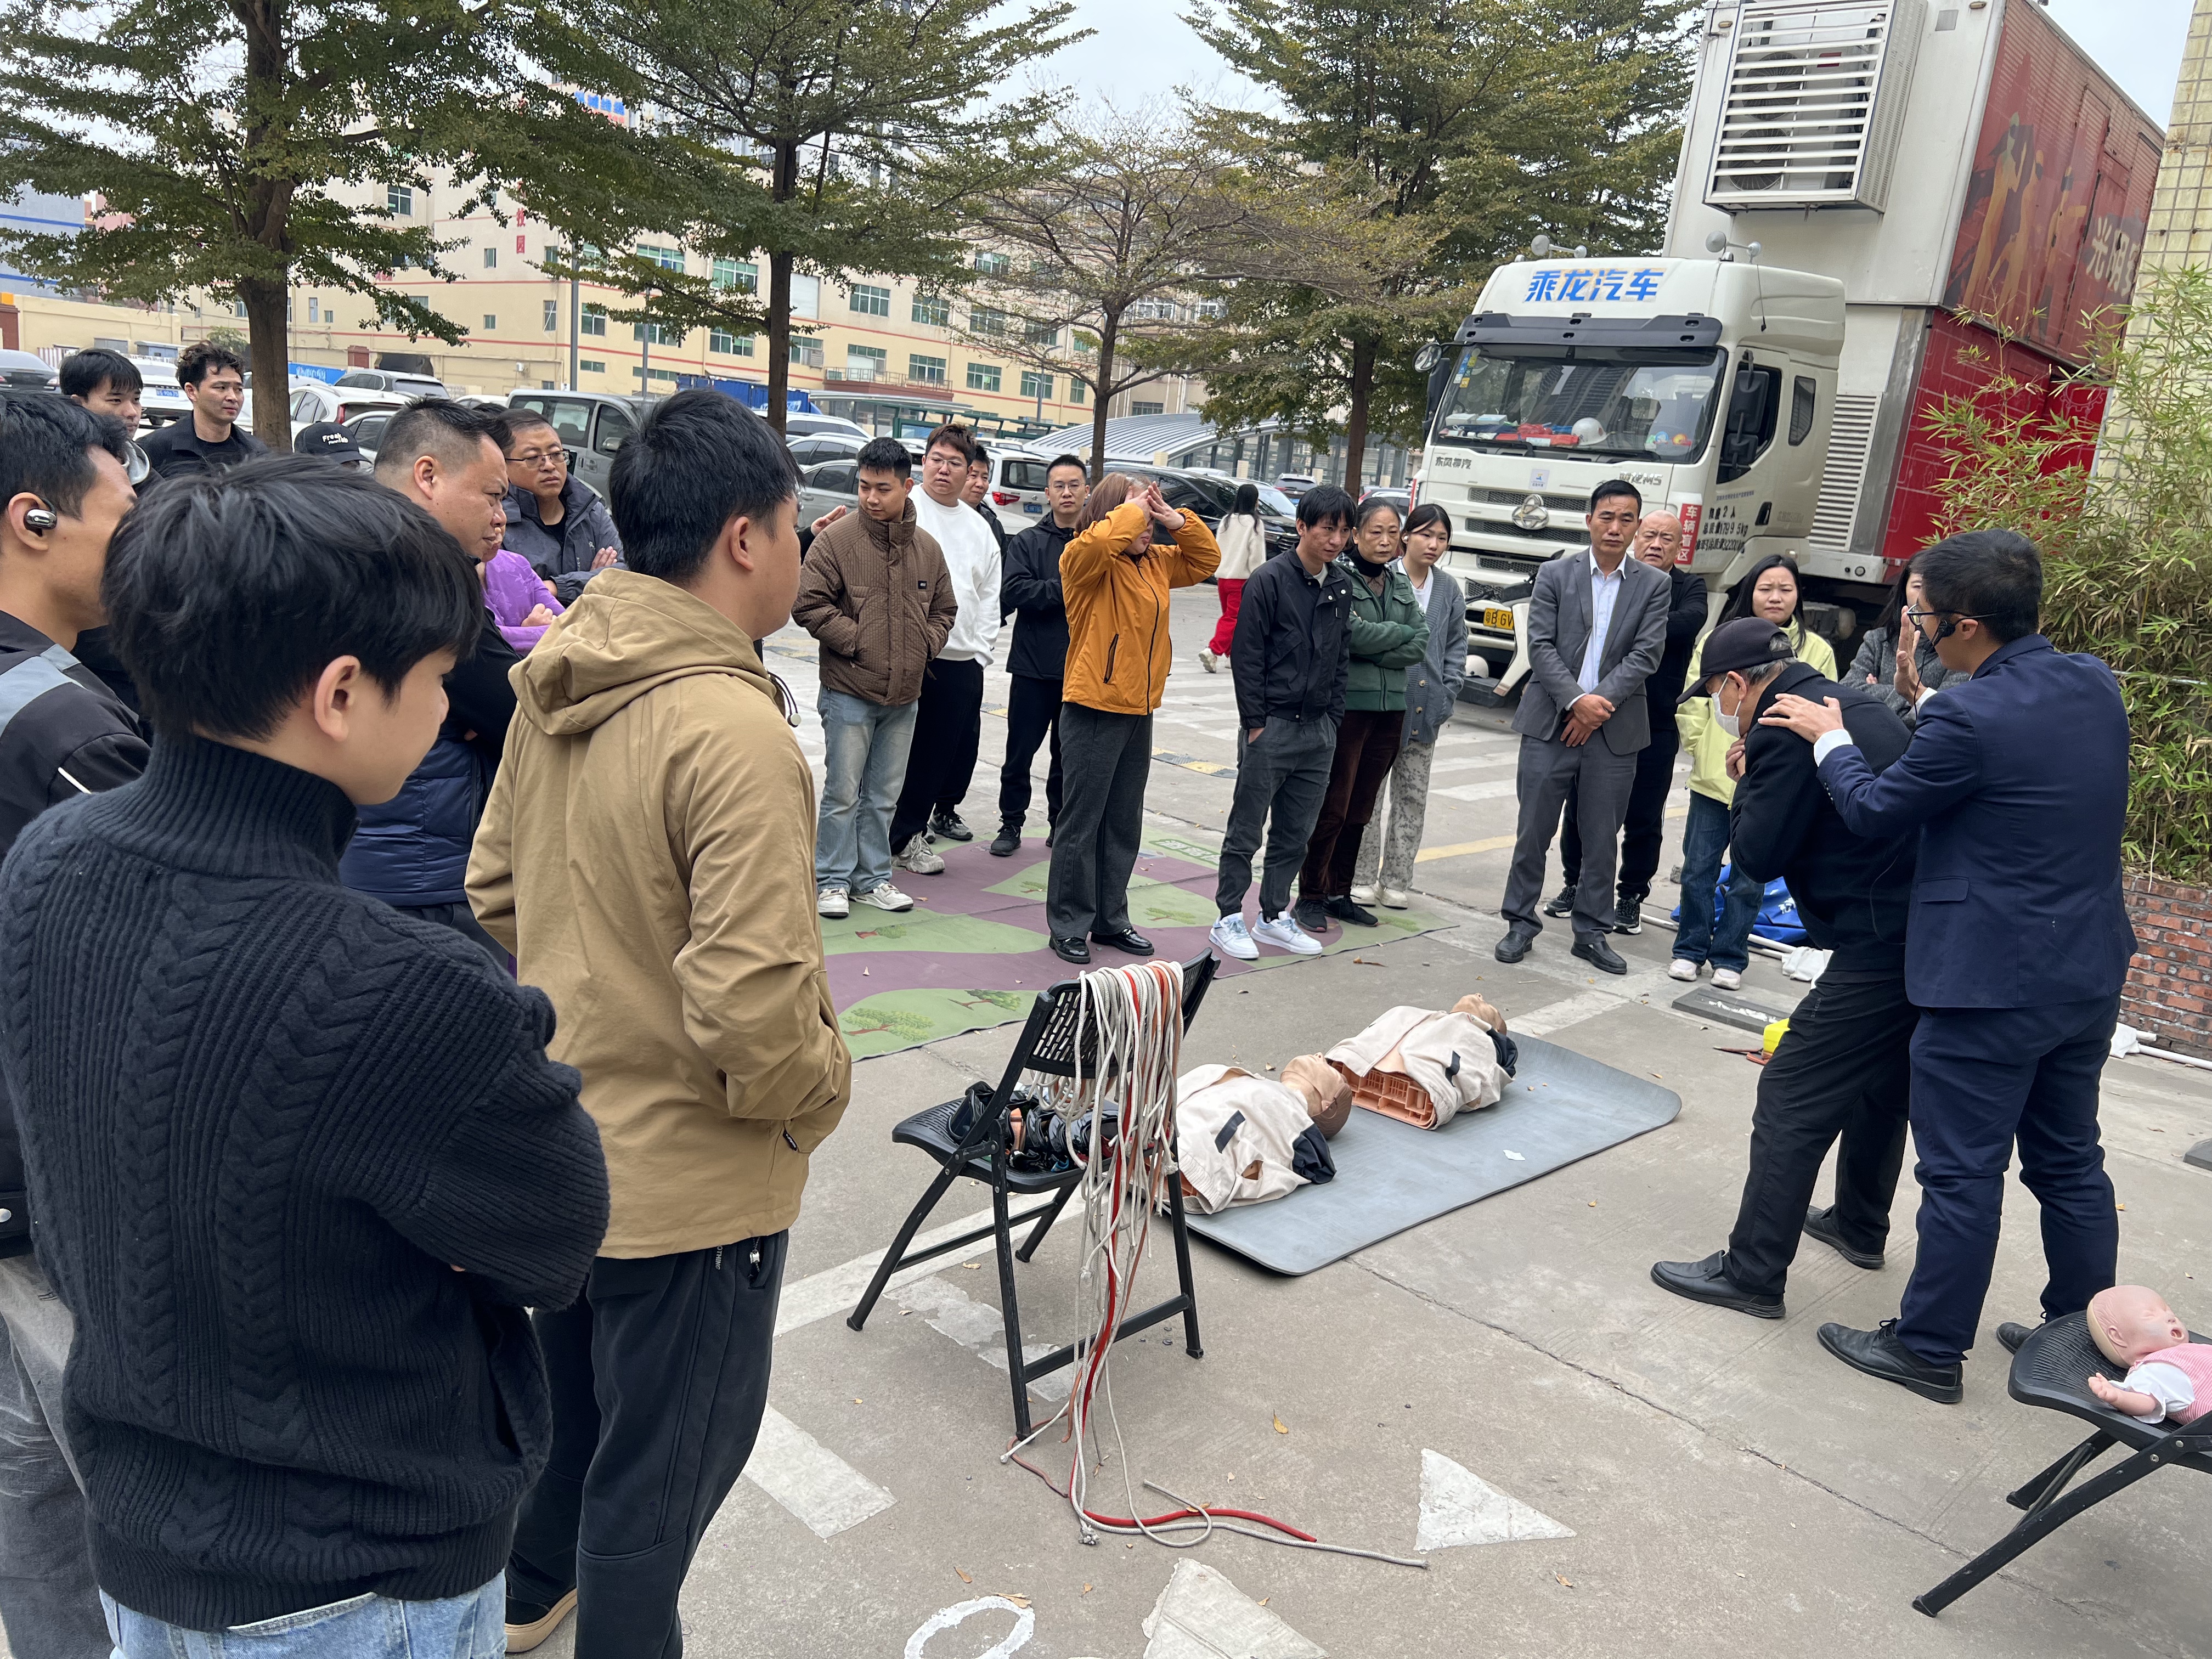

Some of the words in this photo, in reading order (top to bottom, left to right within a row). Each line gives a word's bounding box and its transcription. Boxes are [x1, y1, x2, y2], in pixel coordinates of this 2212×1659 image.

[1525, 269, 1664, 301] 乘龙汽车
[1677, 505, 1699, 562] 车辆盲区
